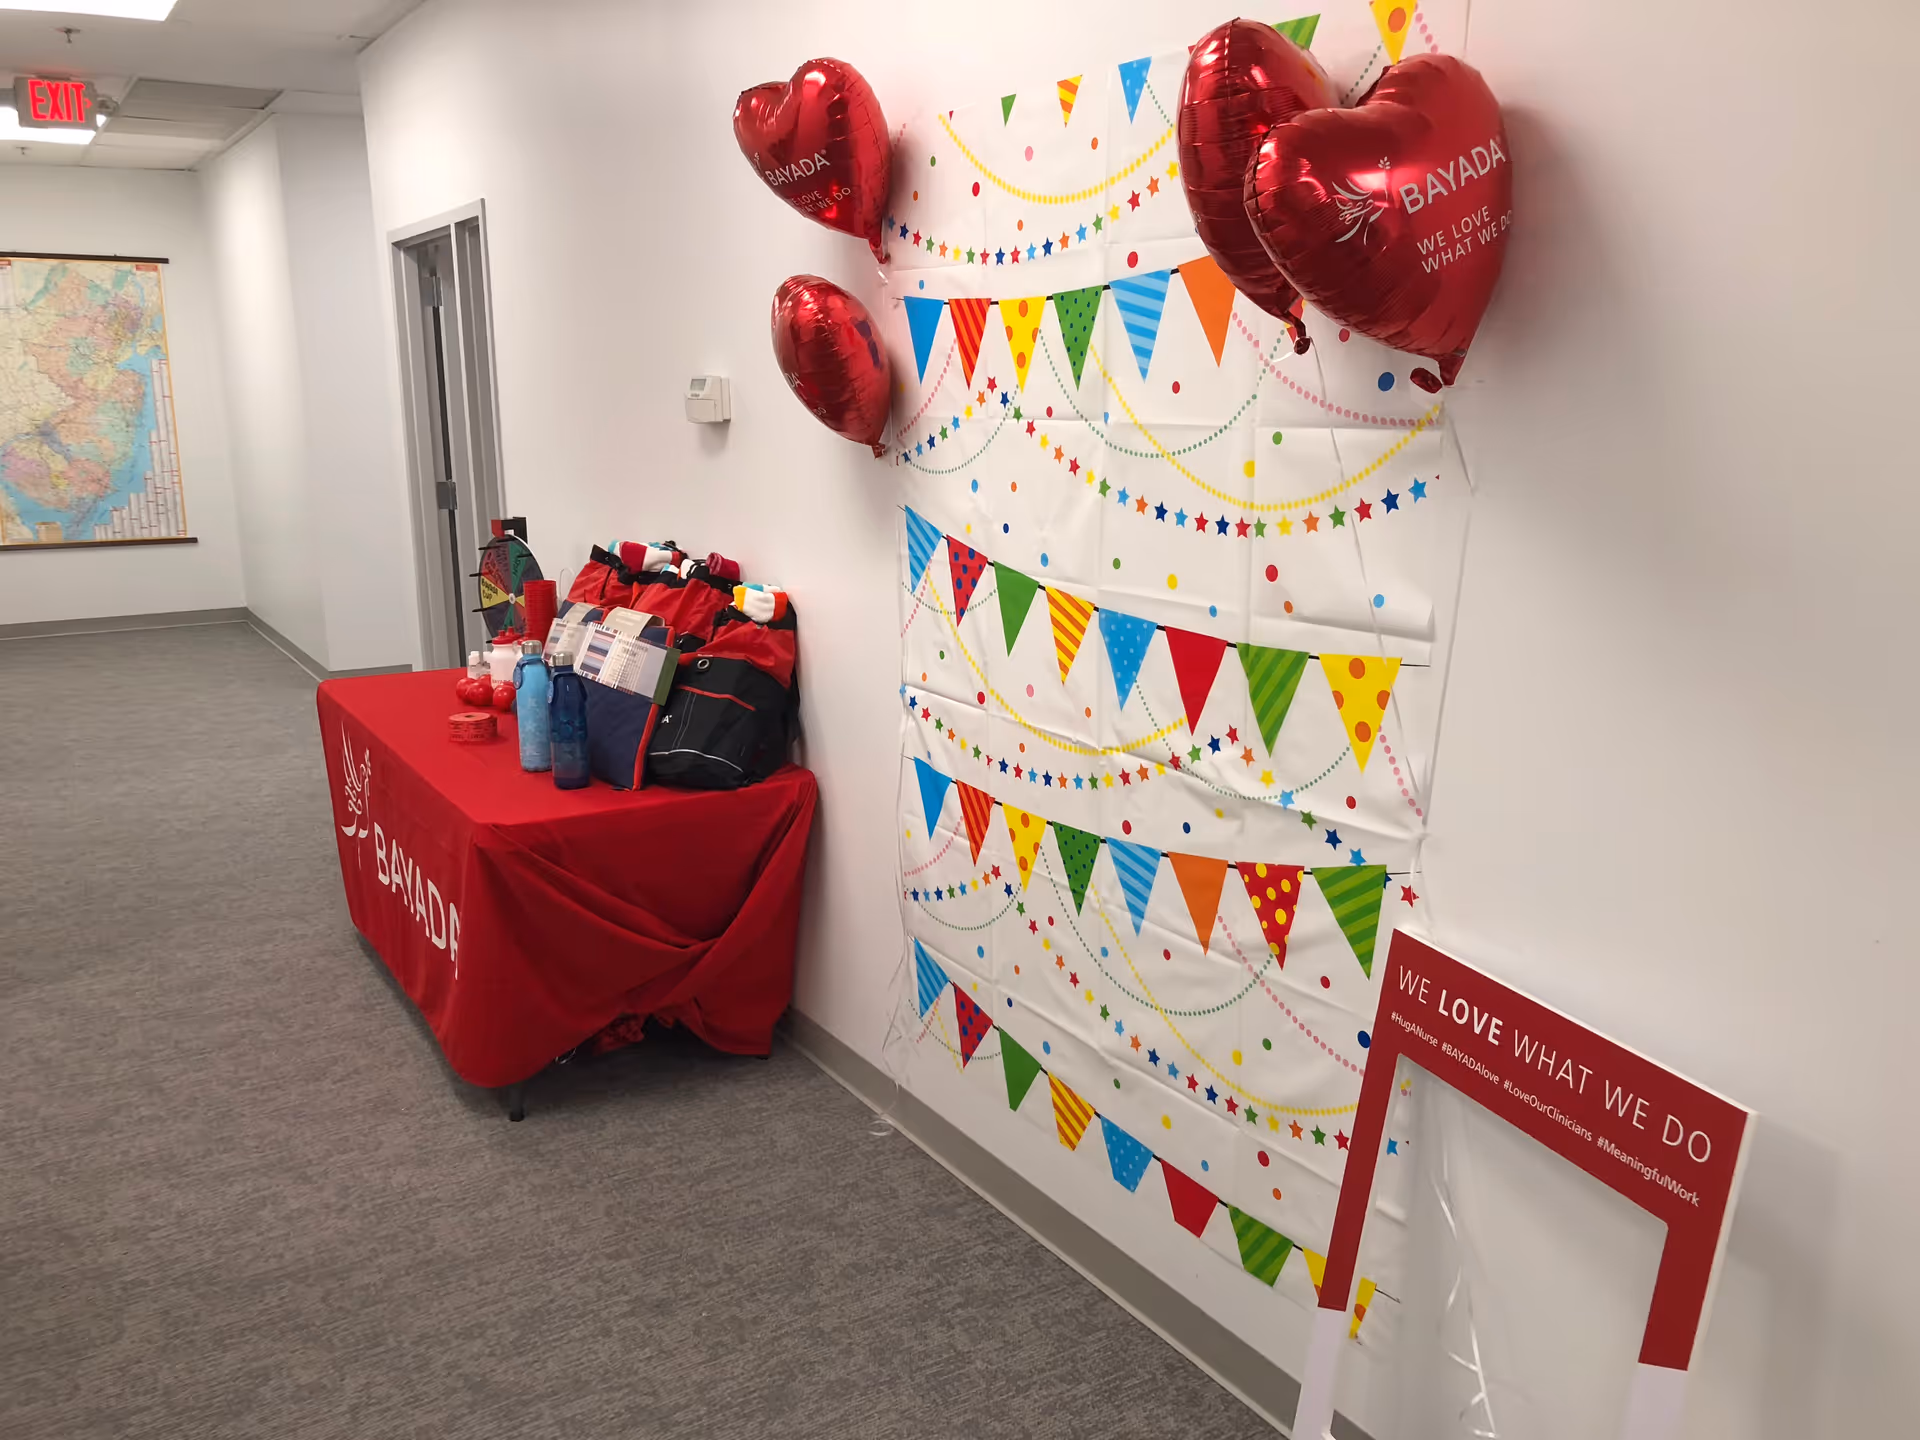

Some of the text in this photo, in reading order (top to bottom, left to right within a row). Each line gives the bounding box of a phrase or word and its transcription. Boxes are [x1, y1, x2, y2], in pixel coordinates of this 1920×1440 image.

[28, 79, 86, 123] EXIT
[797, 190, 822, 205] LOVE
[816, 197, 834, 209] WE
[832, 187, 851, 201] DO
[1399, 138, 1506, 214] BAYADA
[1417, 205, 1491, 256] WE LOVE
[1421, 237, 1473, 274] WHAT
[1477, 221, 1498, 245] WE
[1399, 965, 1711, 1163] WE LOVE WHAT WE DO
[1391, 1011, 1701, 1208] #HugANurse #BAYADAlove #LoveOurClinicians #MeaningfulWork
